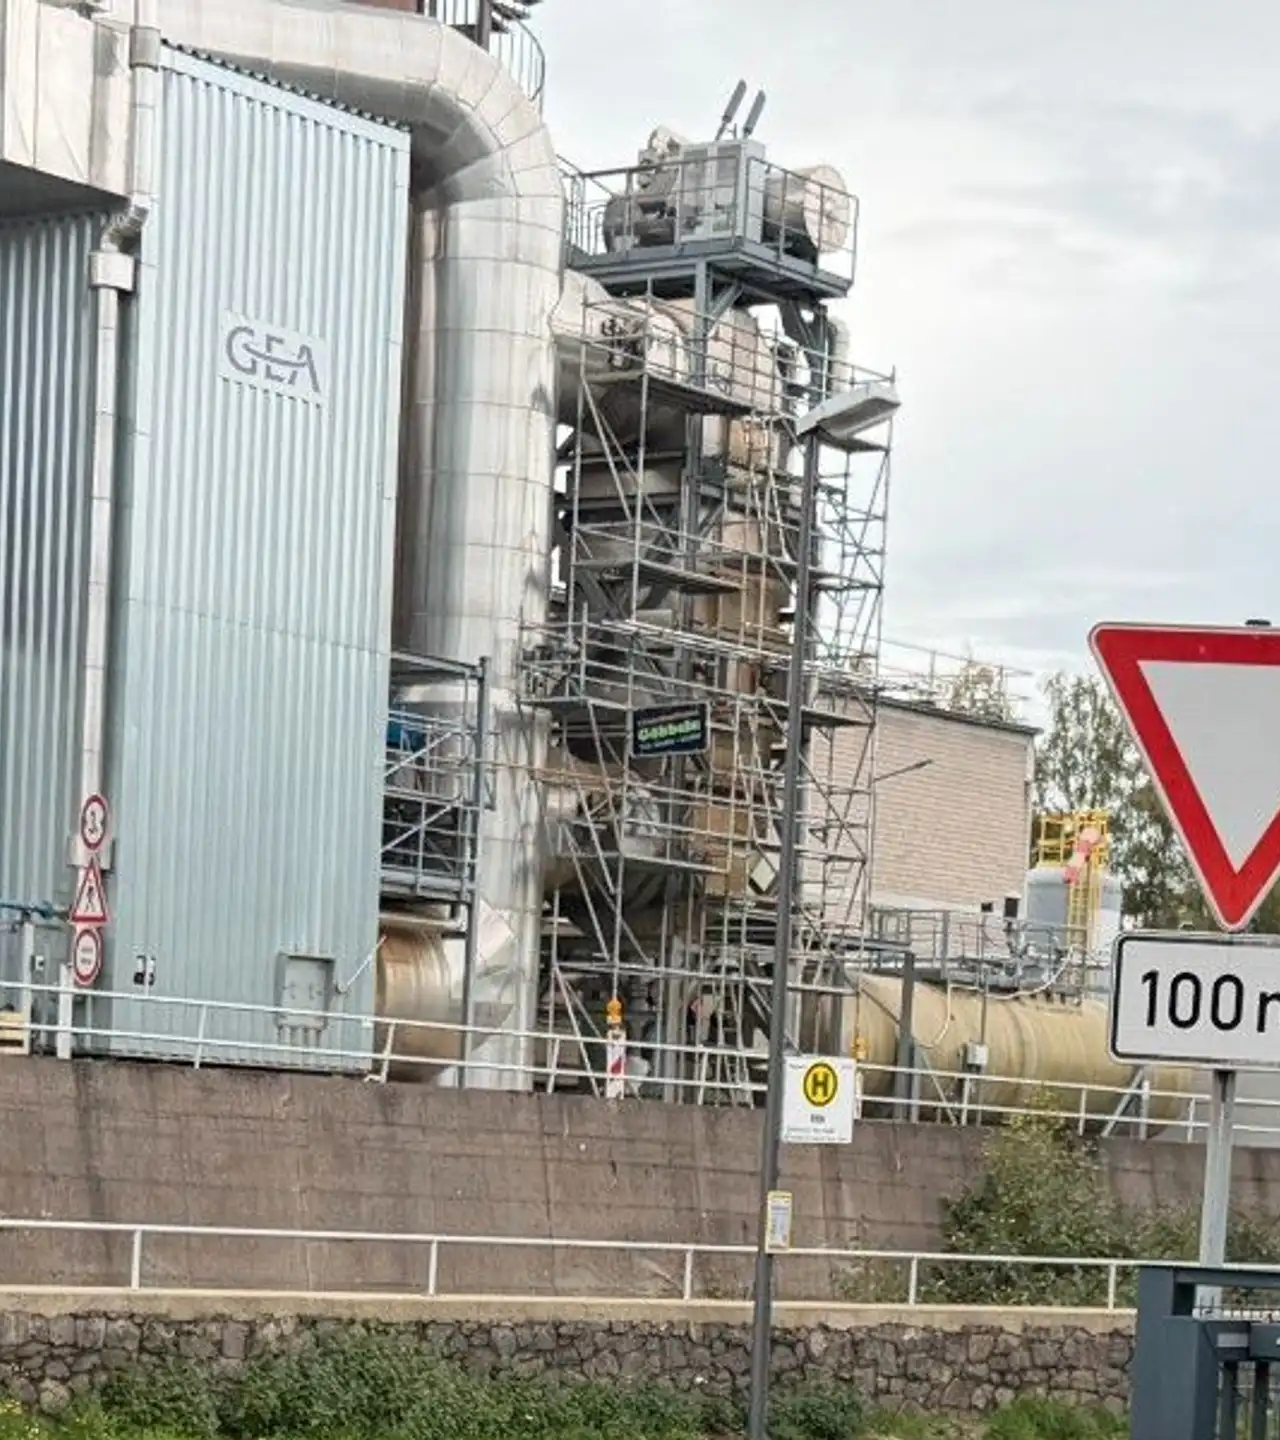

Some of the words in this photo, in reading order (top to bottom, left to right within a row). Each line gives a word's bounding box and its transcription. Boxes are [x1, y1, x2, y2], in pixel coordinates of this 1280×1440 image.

[226, 326, 320, 393] GEA
[1141, 969, 1244, 1031] 100
[811, 1072, 829, 1097] H
